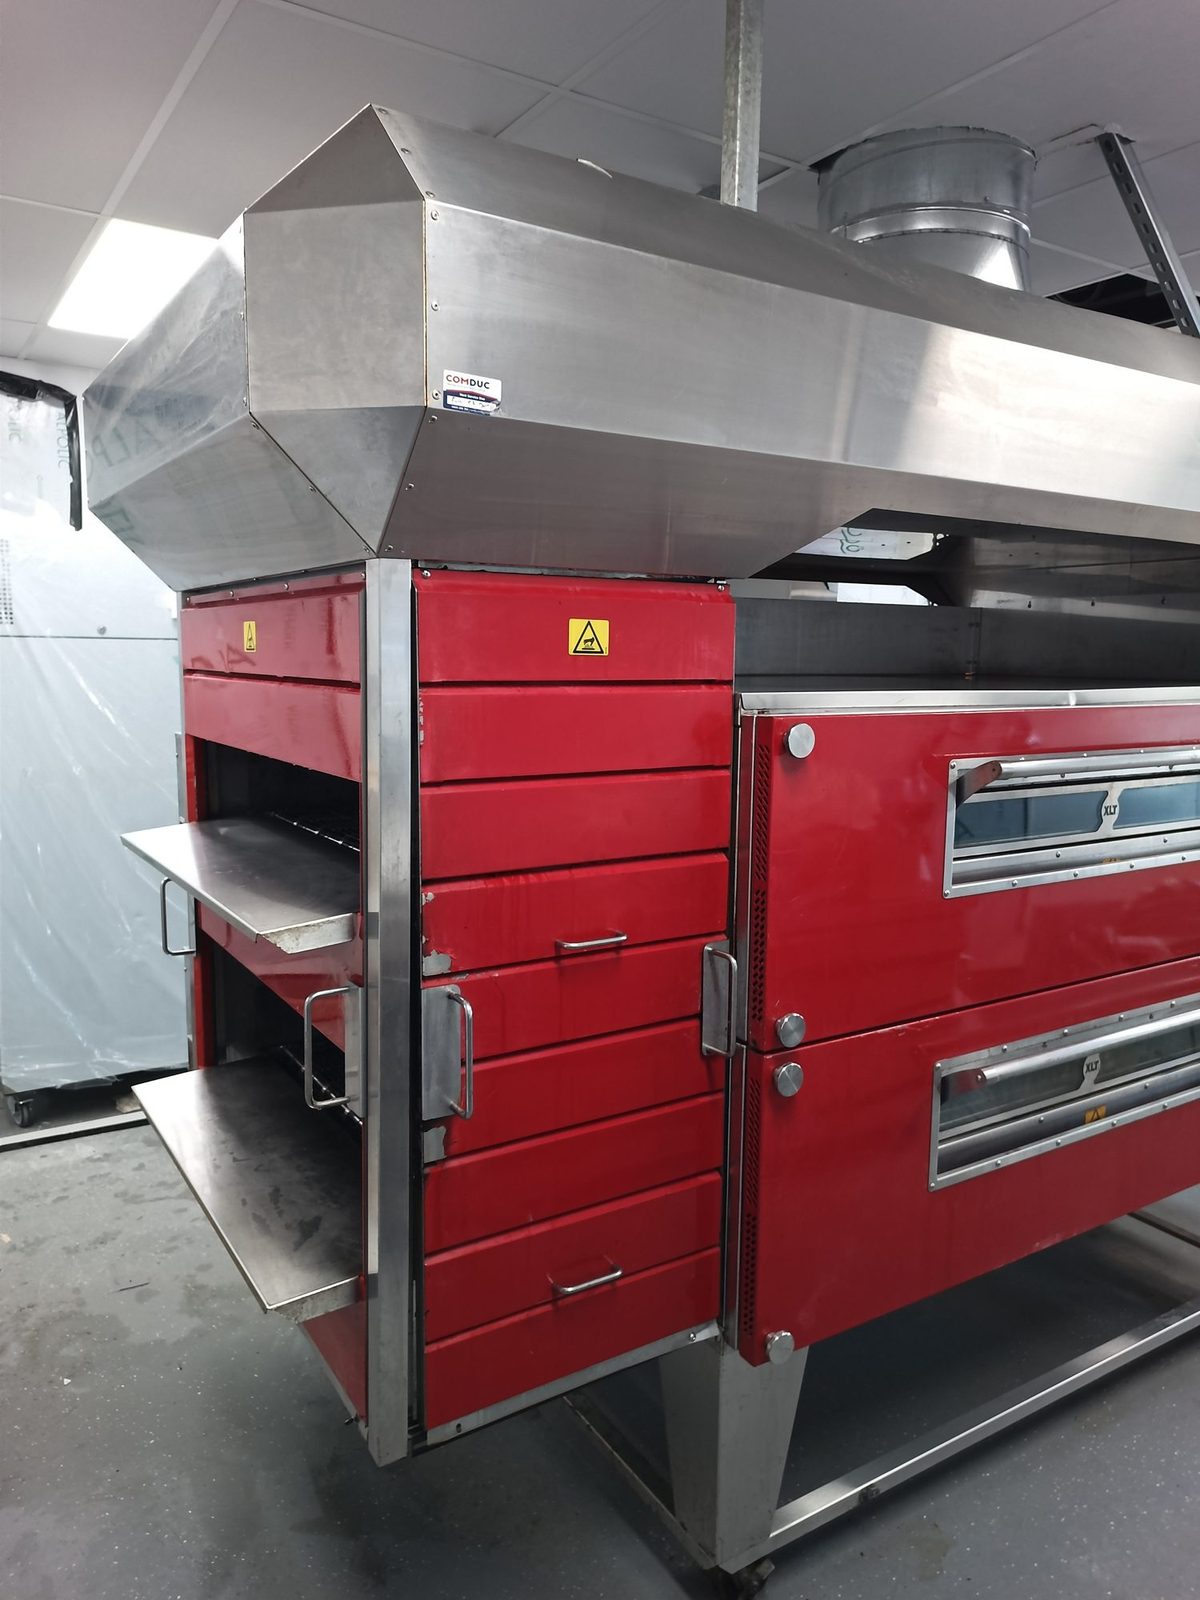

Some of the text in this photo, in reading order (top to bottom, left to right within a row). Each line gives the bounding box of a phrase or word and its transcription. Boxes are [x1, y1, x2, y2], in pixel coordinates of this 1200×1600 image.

[446, 374, 490, 389] COMDUC
[1103, 804, 1118, 816] XLT
[1085, 1060, 1099, 1073] XLT
